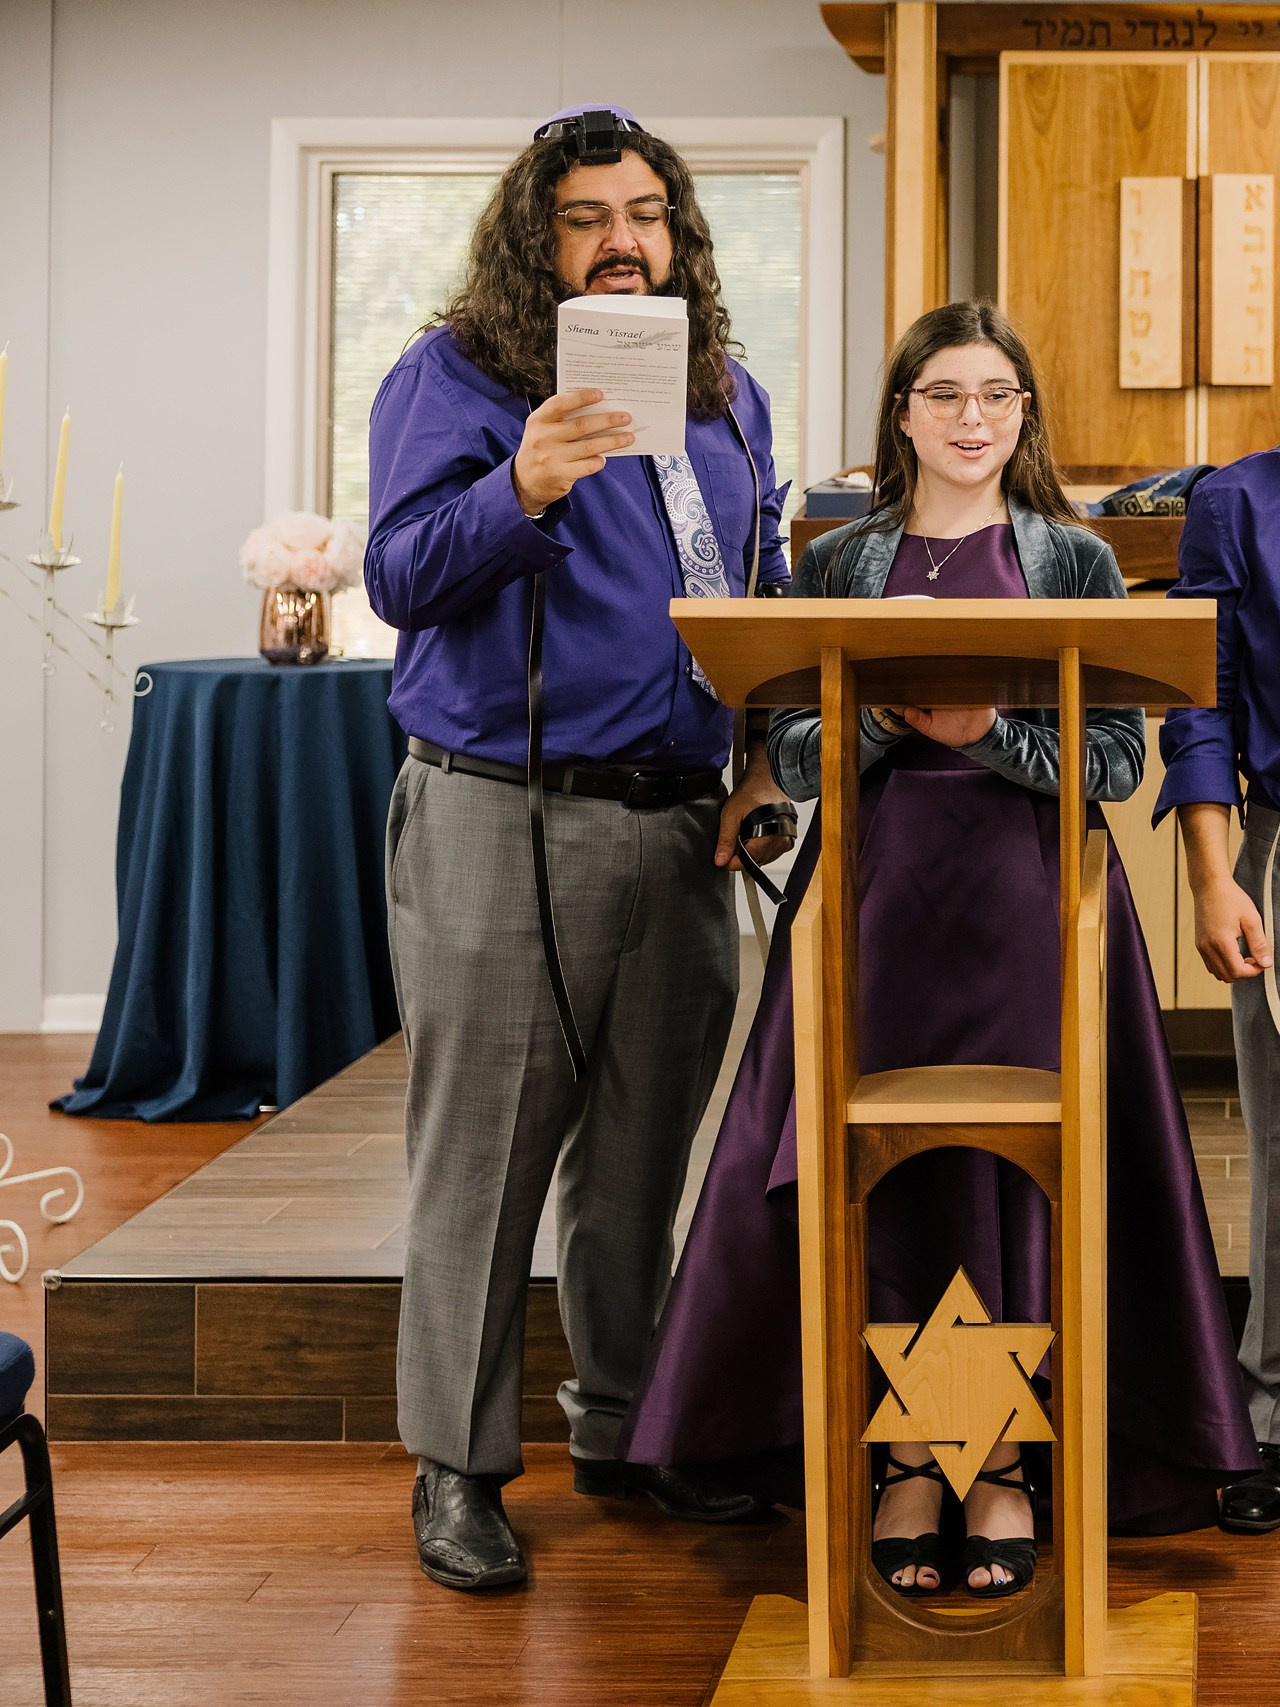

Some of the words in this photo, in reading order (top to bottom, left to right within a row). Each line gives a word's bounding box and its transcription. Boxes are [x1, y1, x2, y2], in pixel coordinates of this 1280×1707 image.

[1021, 18, 1111, 48] תמיד
[1124, 8, 1217, 48] לנגדי
[1237, 20, 1264, 37] יי
[1243, 183, 1265, 212] א
[1248, 265, 1265, 294] ג
[565, 324, 600, 336] Shema
[606, 328, 646, 340] Yisrael
